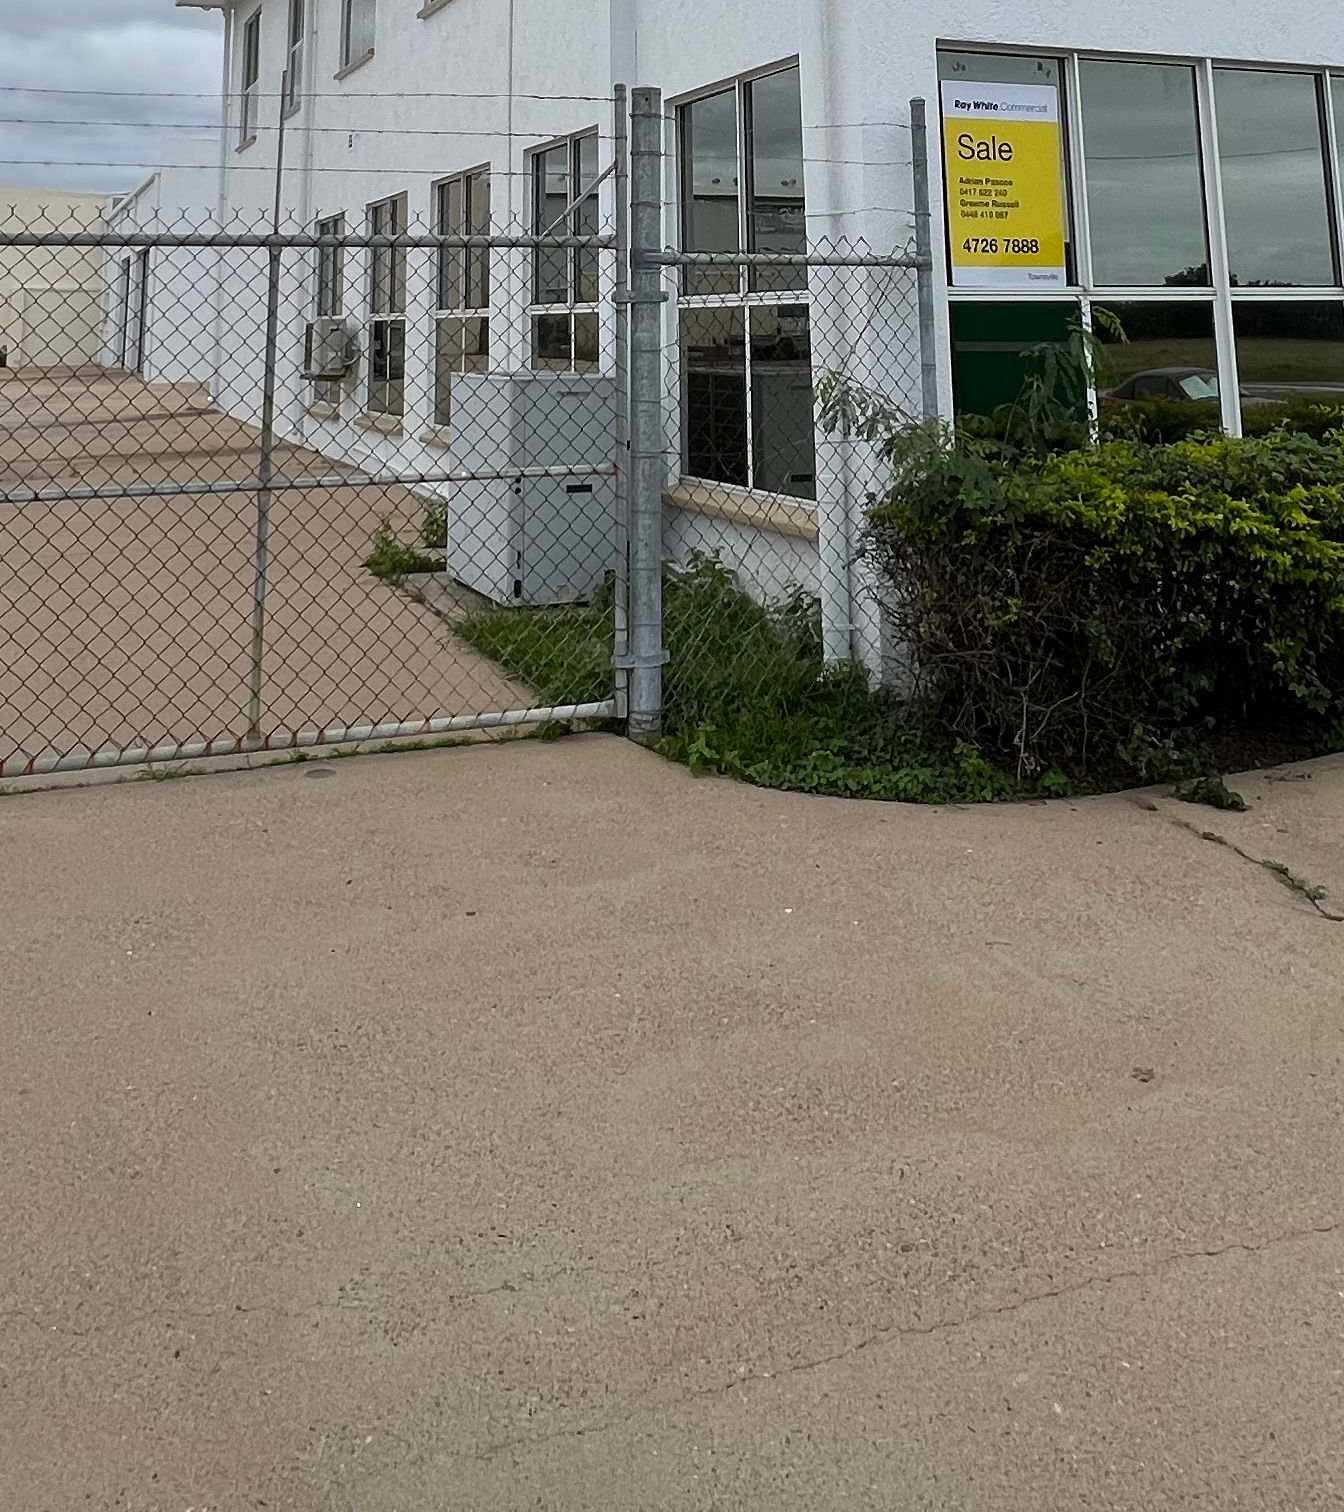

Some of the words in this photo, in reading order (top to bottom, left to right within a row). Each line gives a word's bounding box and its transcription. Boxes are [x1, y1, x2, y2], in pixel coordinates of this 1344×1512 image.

[954, 99, 972, 111] Ray
[973, 100, 999, 111] White
[1001, 101, 1048, 113] Commercial
[958, 133, 1013, 161] Sale
[962, 238, 998, 254] 4726
[1003, 238, 1039, 254] 7888
